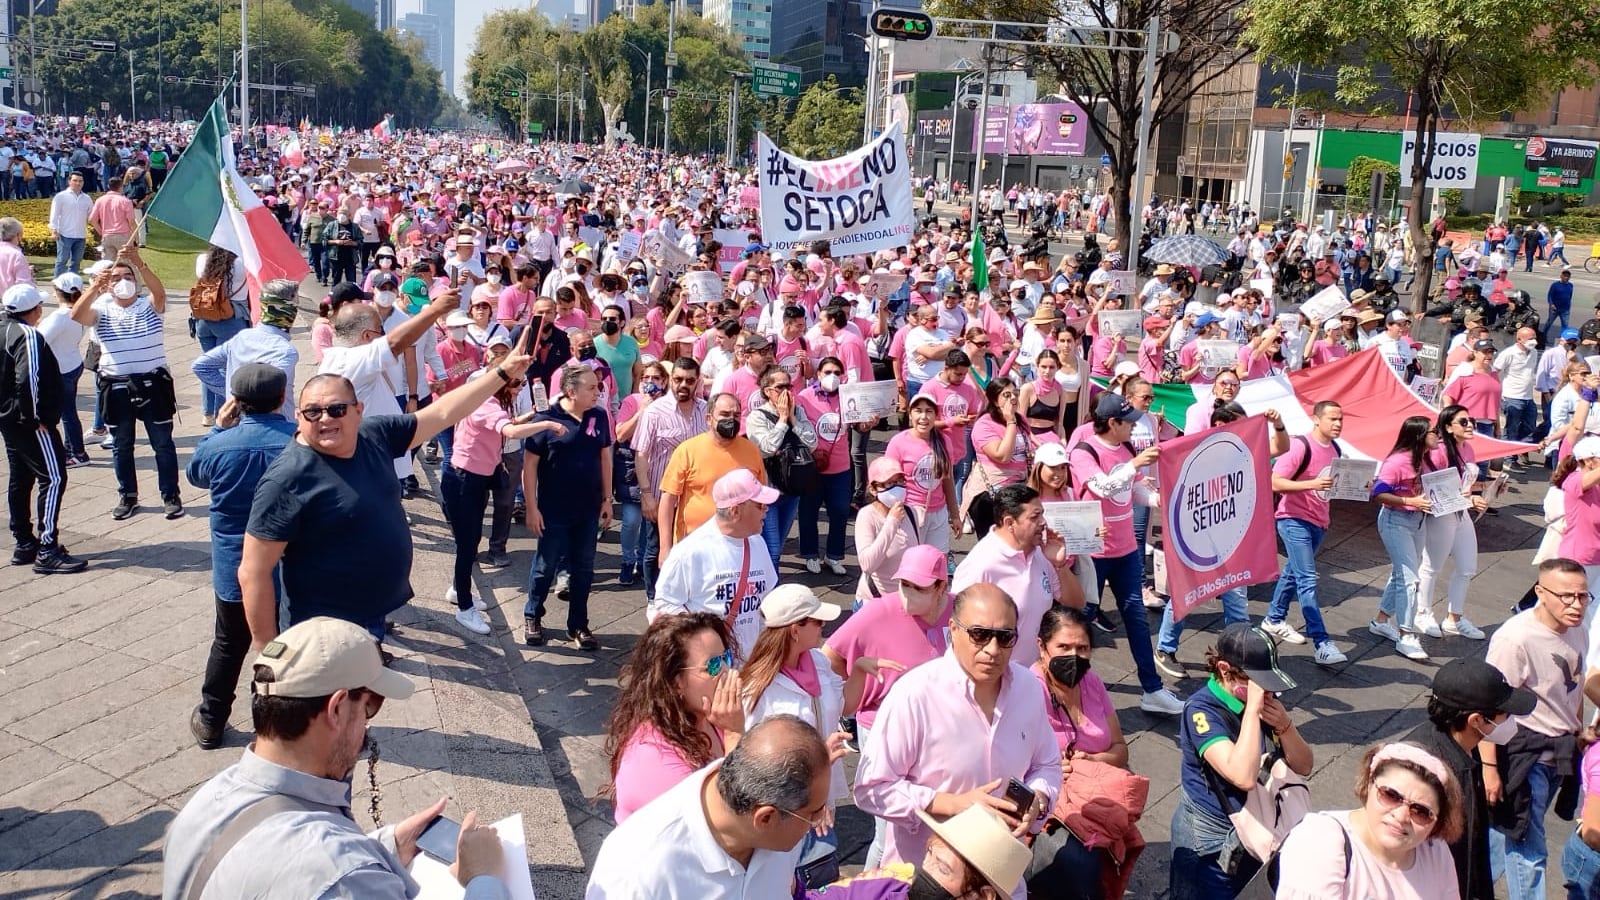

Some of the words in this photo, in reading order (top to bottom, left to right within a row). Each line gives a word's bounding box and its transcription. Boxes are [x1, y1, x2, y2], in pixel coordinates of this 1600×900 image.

[919, 119, 934, 136] THE
[767, 137, 897, 193] #ELINENO
[1411, 166, 1467, 181] AJOS
[784, 183, 891, 232] SETOCA
[1187, 470, 1243, 511] #ELINENO
[1193, 497, 1236, 533] SETOCA
[724, 595, 762, 616] STOCA
[1192, 711, 1211, 735] 3
